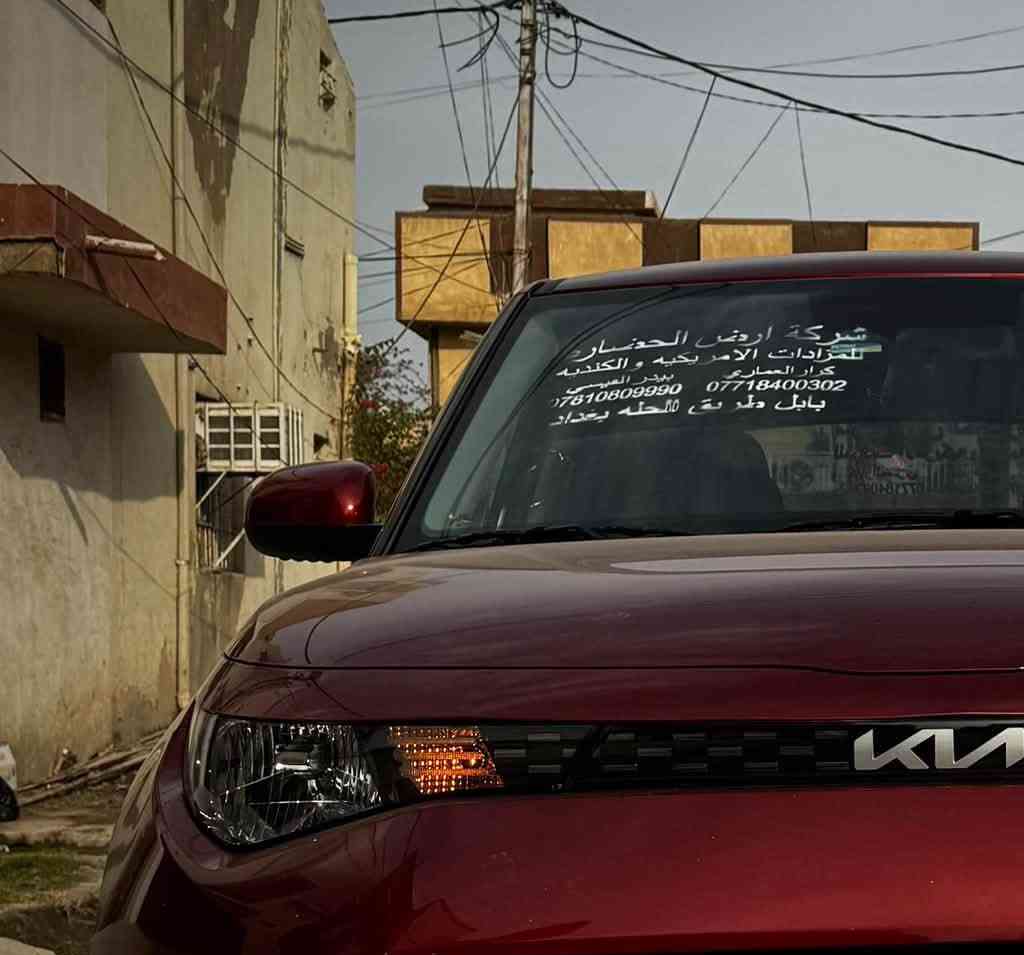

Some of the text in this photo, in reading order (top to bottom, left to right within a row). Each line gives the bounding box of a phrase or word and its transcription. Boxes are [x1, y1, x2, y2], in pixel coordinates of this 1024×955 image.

[694, 324, 774, 348] ارض
[784, 324, 867, 346] شركة
[705, 379, 848, 392] 07718400302
[774, 394, 827, 411] بابل
[854, 727, 1024, 770] KIA
